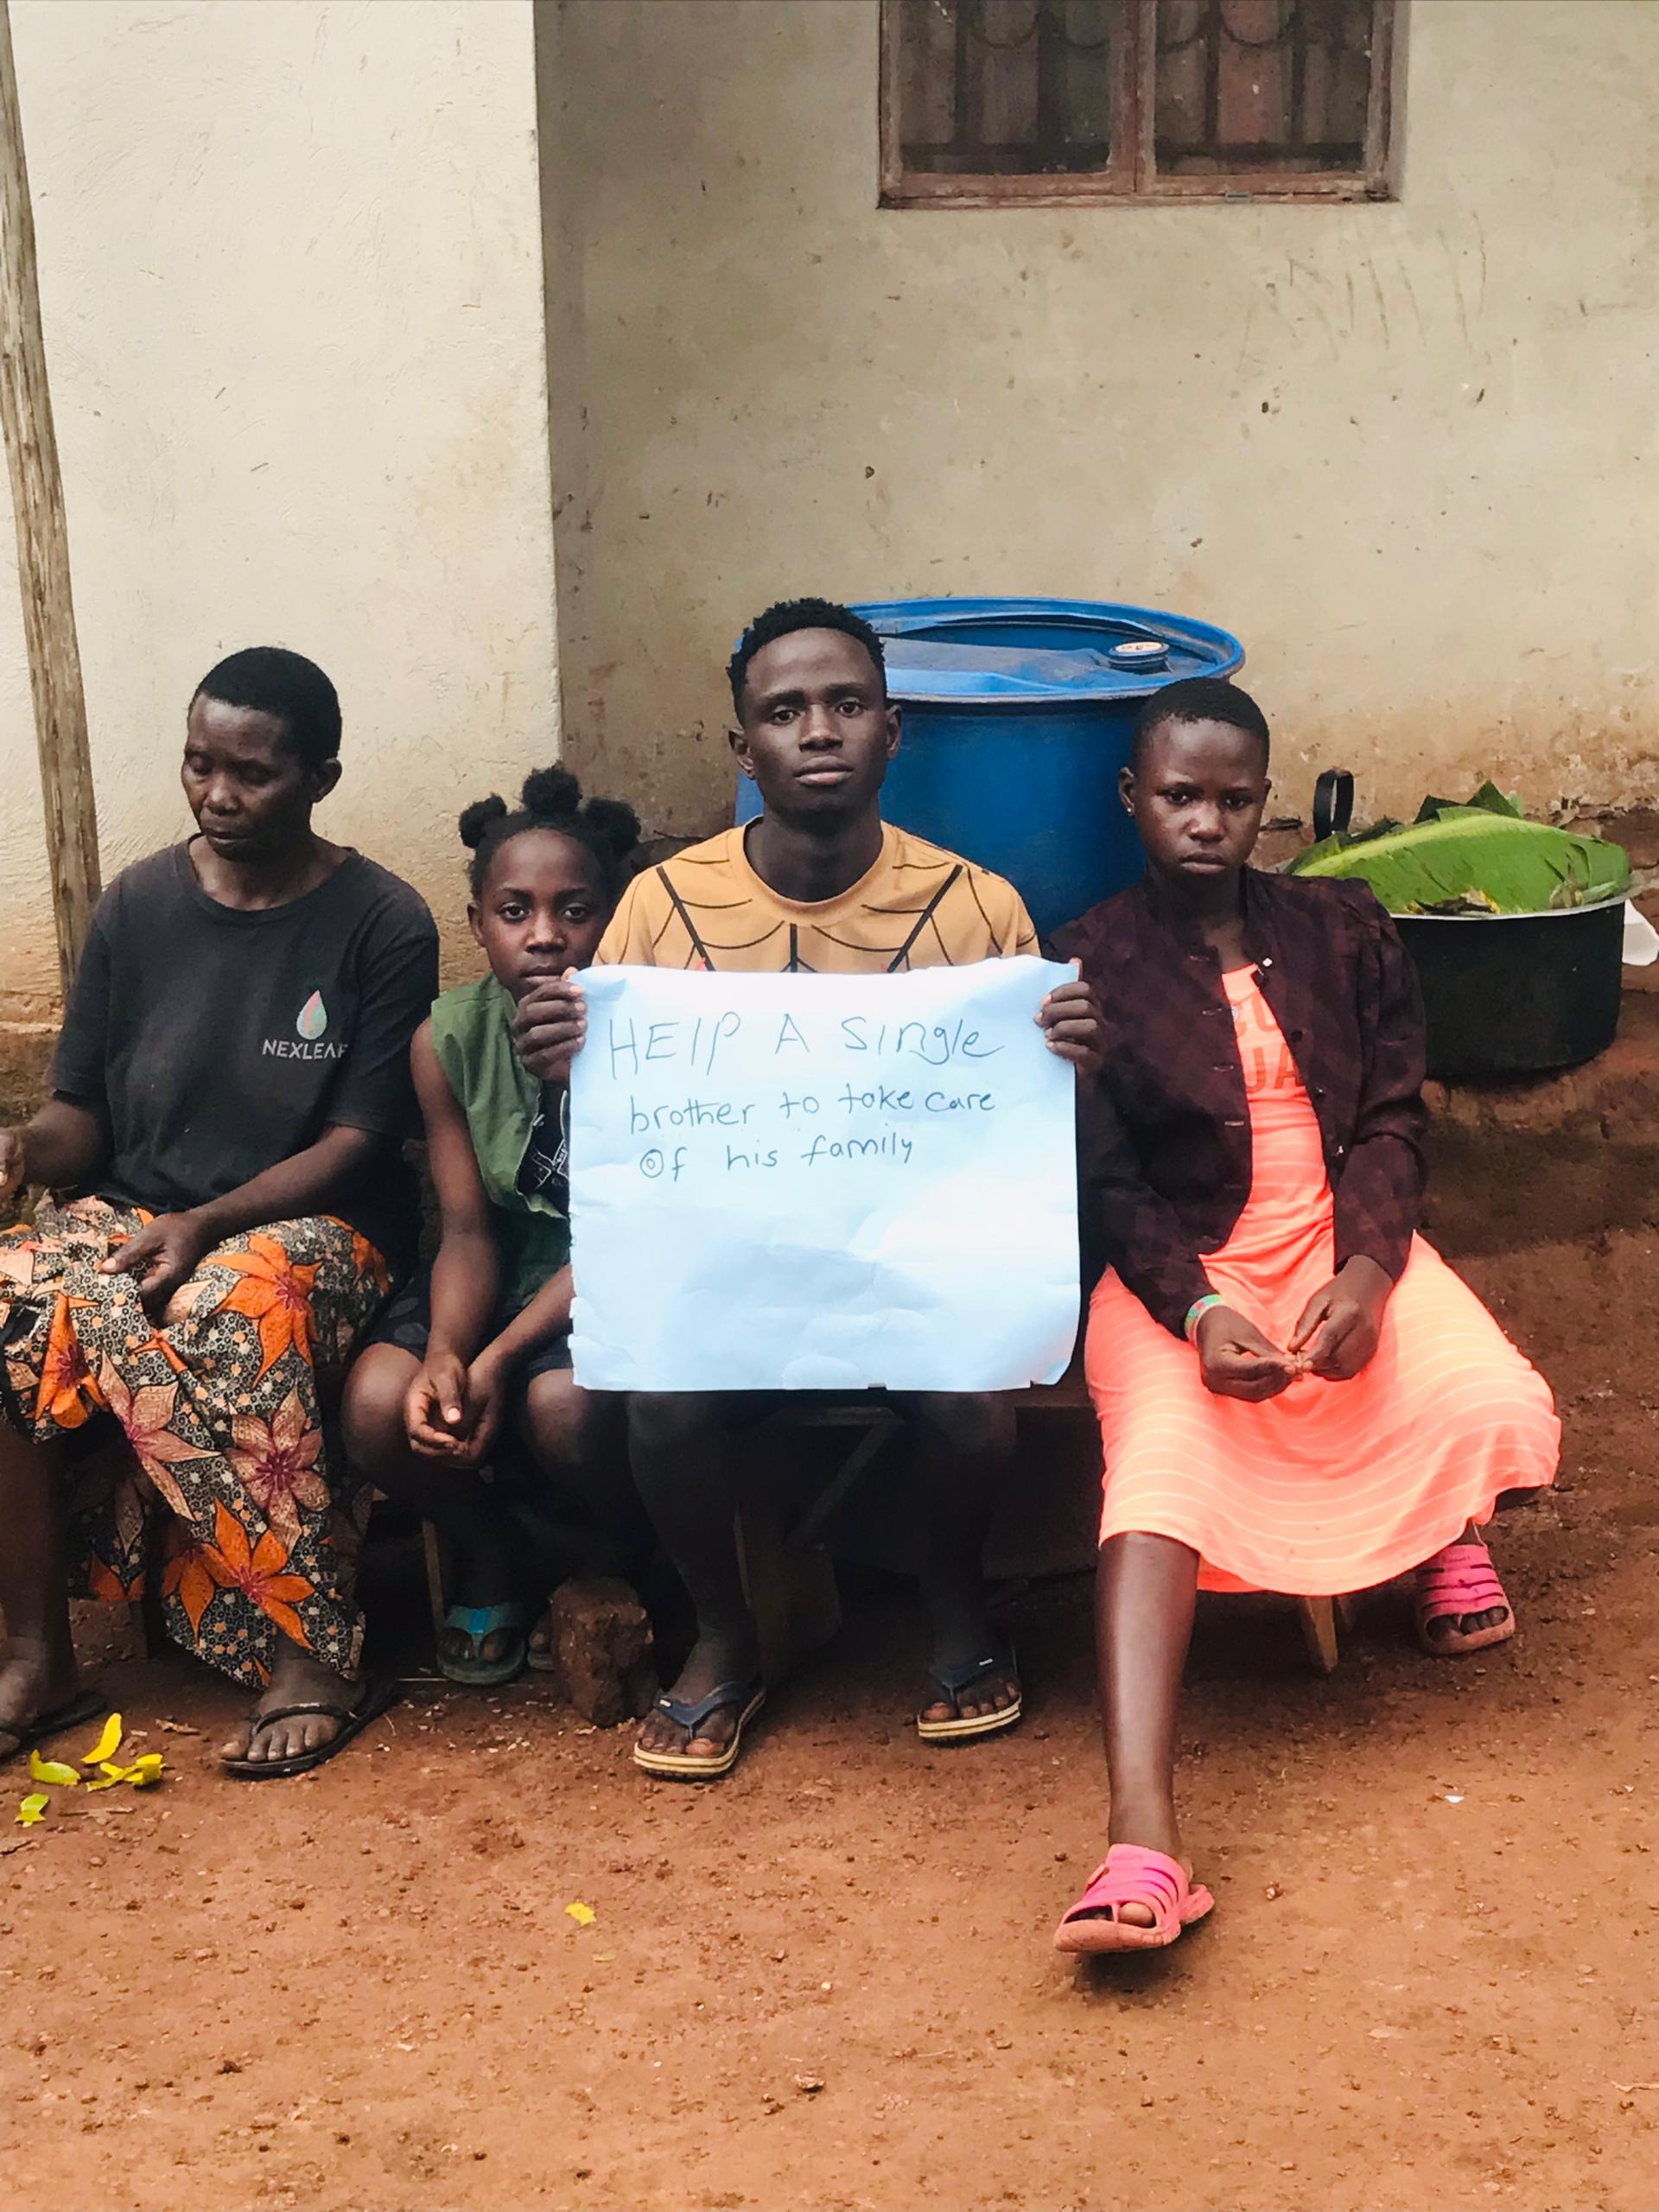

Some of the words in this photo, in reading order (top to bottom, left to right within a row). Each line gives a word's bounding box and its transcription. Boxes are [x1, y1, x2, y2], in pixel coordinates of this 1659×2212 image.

[774, 1013, 810, 1055] A
[630, 1095, 756, 1135] brother
[779, 1091, 820, 1120] to
[925, 1091, 996, 1113] care
[639, 1146, 689, 1183] Of
[726, 1139, 779, 1172] his
[800, 1130, 912, 1166] family
